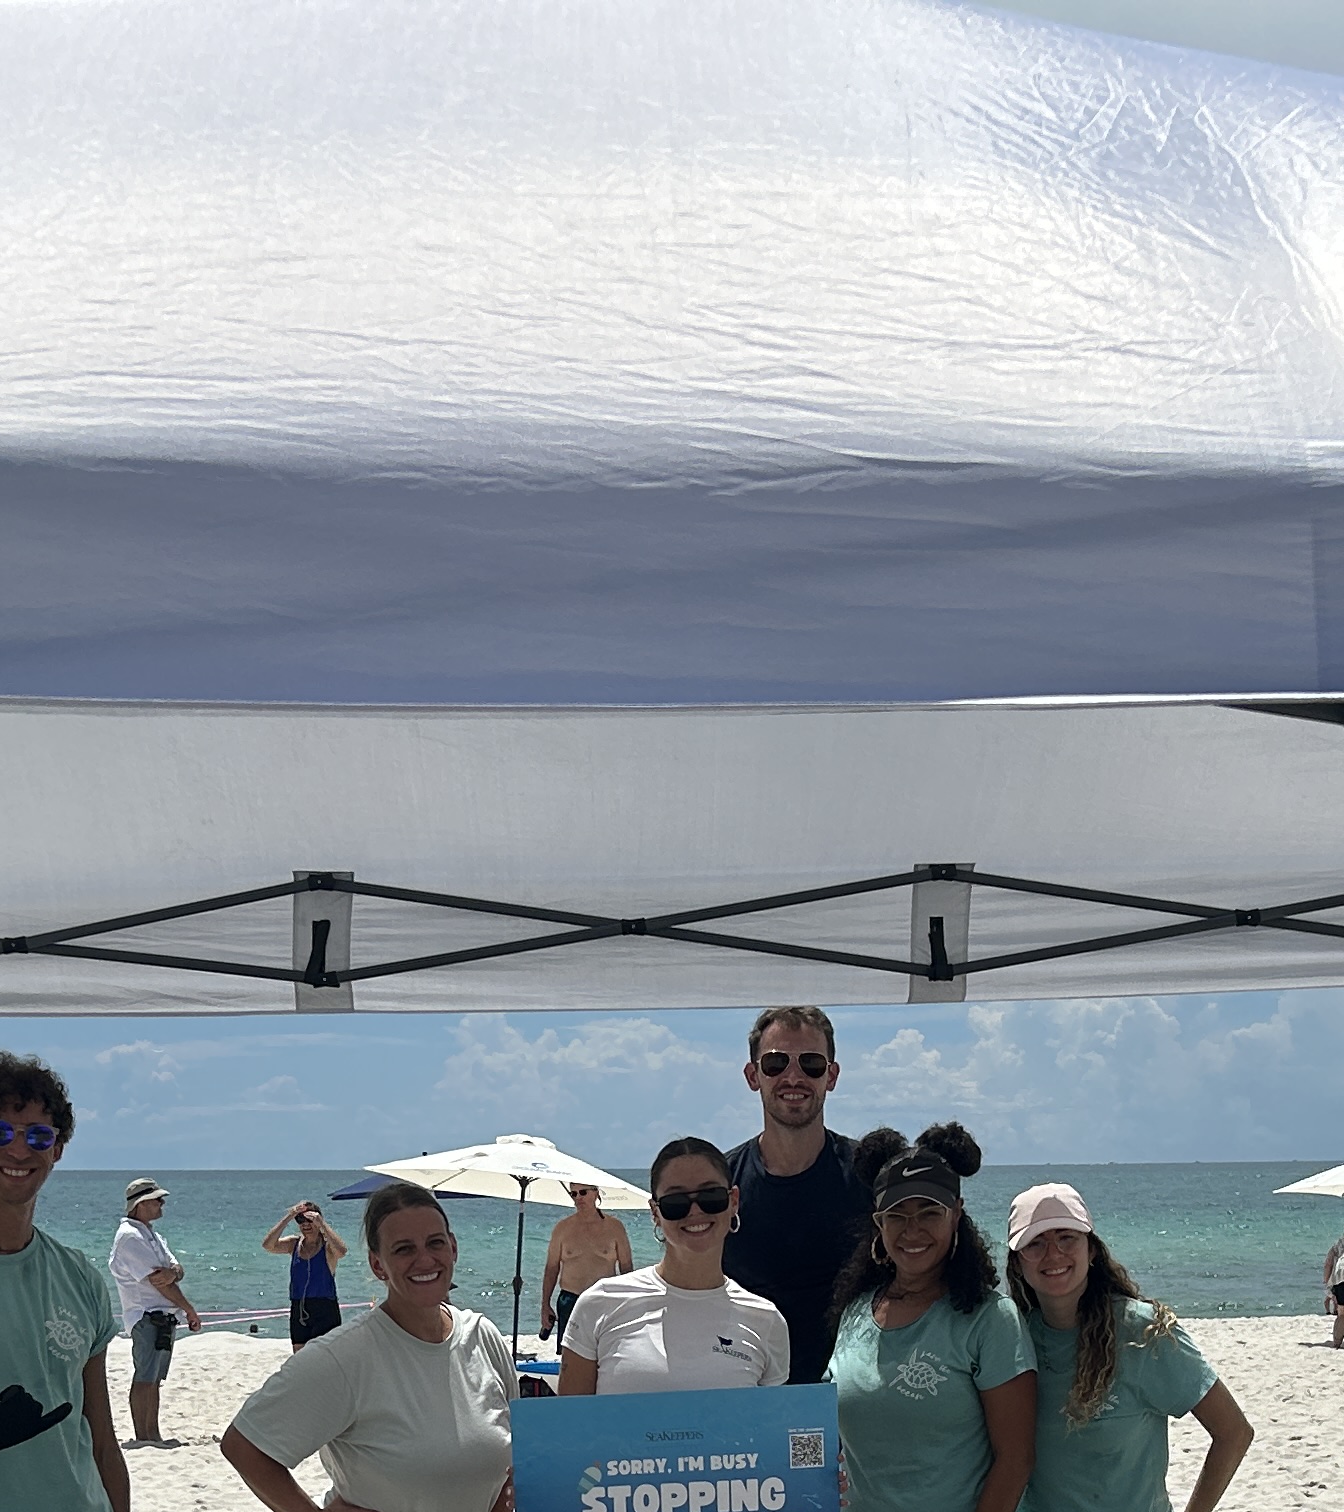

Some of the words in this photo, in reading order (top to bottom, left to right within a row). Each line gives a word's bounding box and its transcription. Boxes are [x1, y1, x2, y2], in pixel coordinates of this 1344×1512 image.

[606, 1457, 672, 1477] SORRY,
[677, 1455, 709, 1473] I'M
[710, 1453, 759, 1472] BUSY
